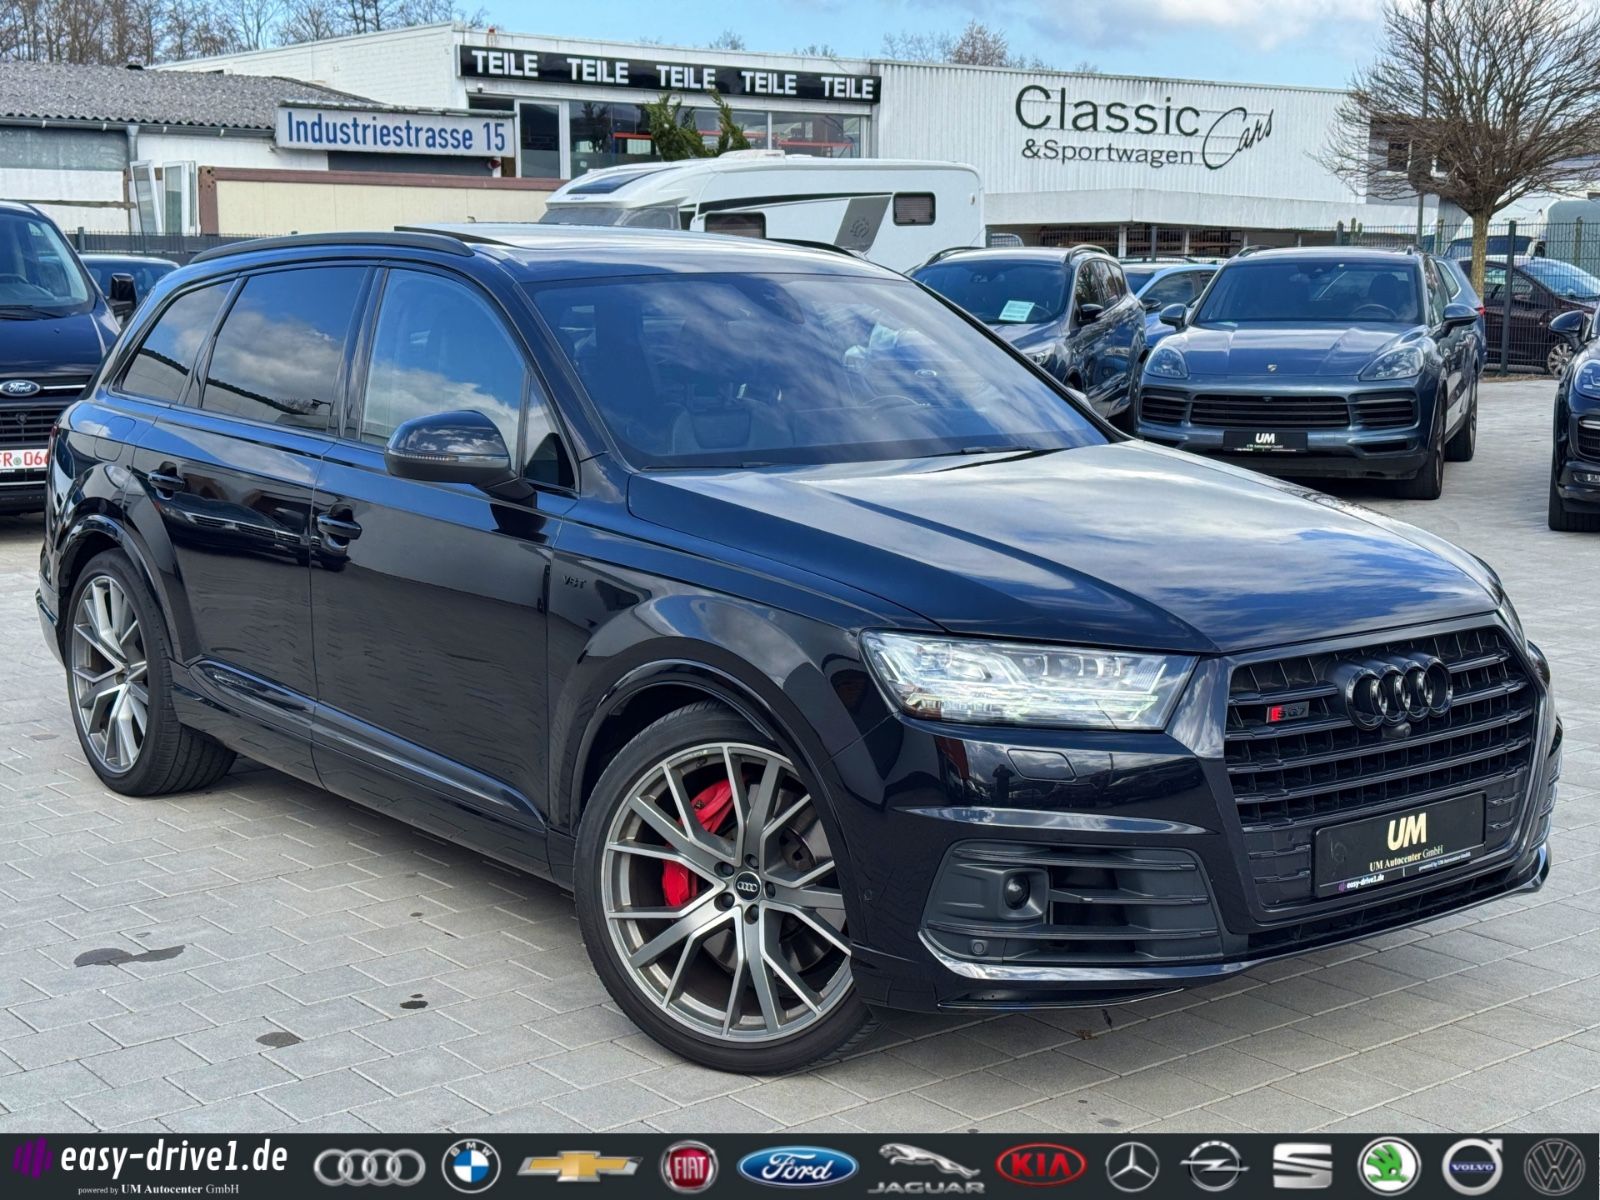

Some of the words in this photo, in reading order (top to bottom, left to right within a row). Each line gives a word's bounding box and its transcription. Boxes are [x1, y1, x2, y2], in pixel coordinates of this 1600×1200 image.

[471, 50, 539, 77] TEILE
[566, 57, 629, 84] TEILE
[656, 65, 717, 90] TEILE
[741, 71, 797, 95] TEILE
[821, 77, 874, 99] TEILE
[1015, 84, 1200, 137] Classic
[287, 111, 473, 150] Industriestrasse
[482, 122, 506, 151] 15
[1202, 107, 1274, 170] Cars
[1021, 138, 1194, 169] &Sportwagen
[8, 382, 32, 392] Ford
[1255, 433, 1275, 444] UM
[1387, 812, 1427, 851] UM
[1369, 862, 1384, 872] UM
[1385, 853, 1421, 868] Autocenter
[1422, 845, 1443, 857] GmbH
